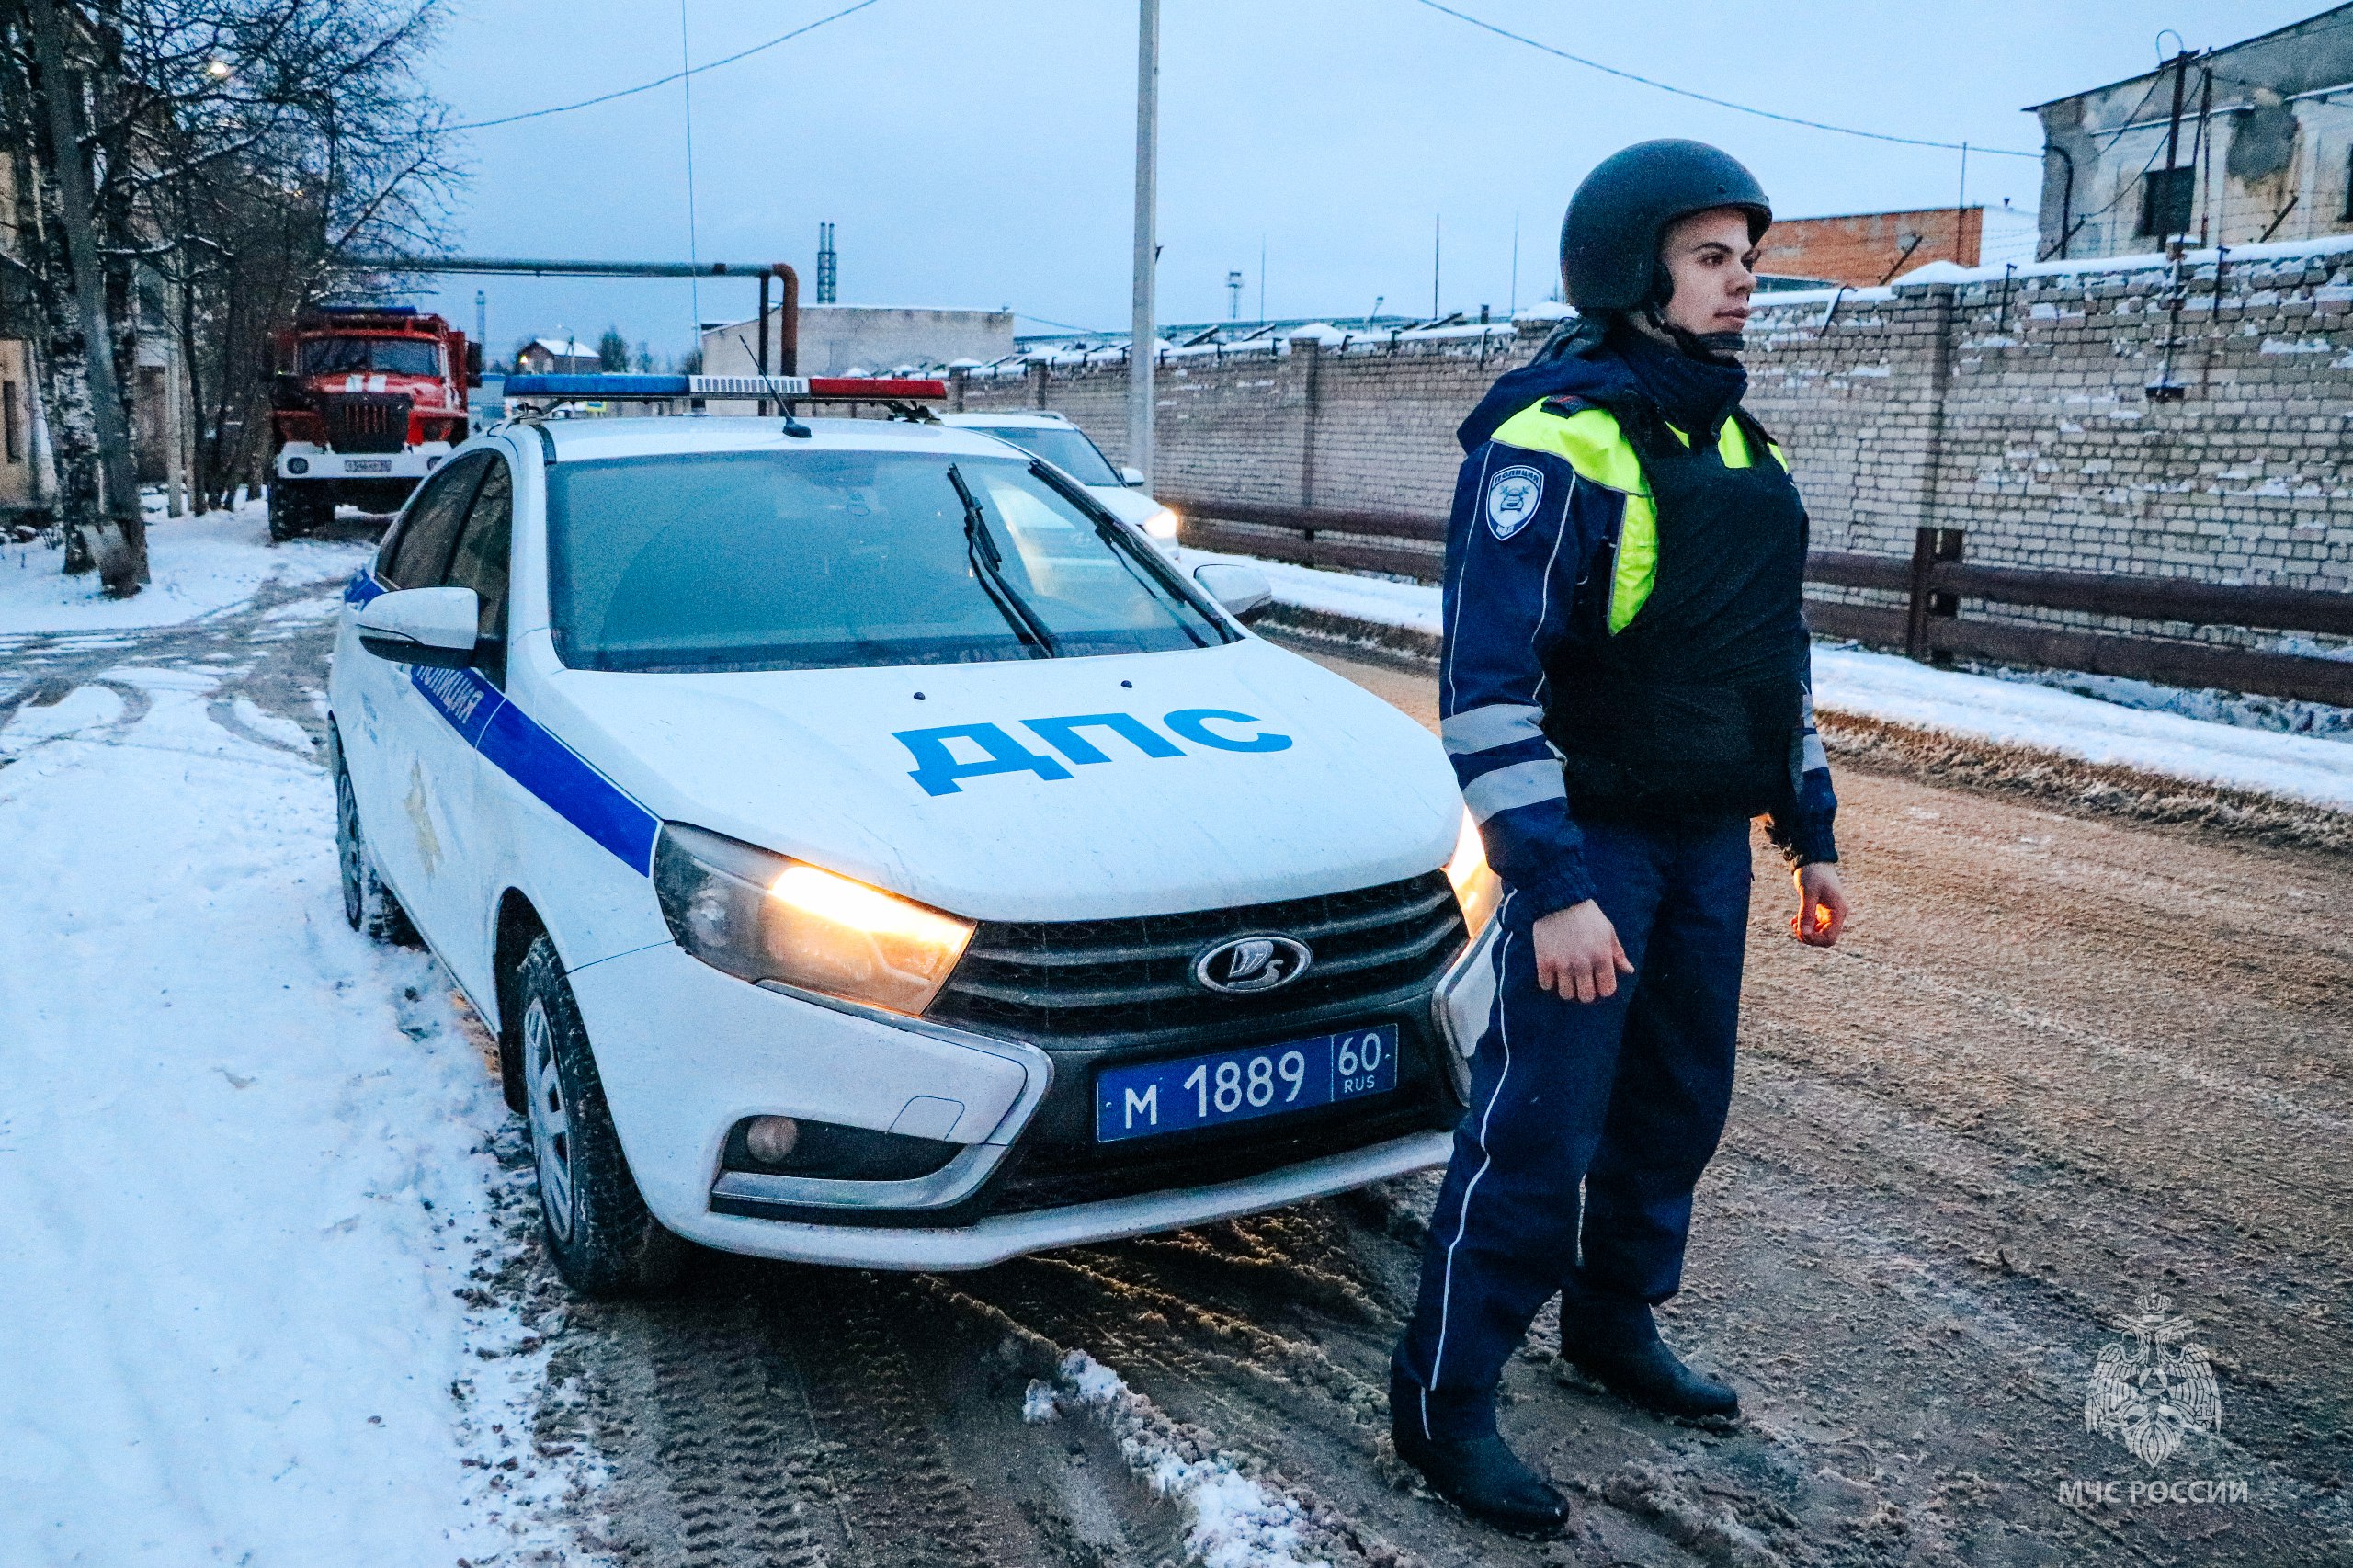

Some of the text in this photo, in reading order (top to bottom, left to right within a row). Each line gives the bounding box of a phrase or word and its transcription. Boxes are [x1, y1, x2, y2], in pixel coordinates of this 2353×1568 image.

[1494, 469, 1540, 484] ПОЛИЦИЯ
[892, 709, 1292, 797] ДПС
[1124, 1032, 1381, 1129] М 1889 60
[1344, 1074, 1376, 1094] RUS
